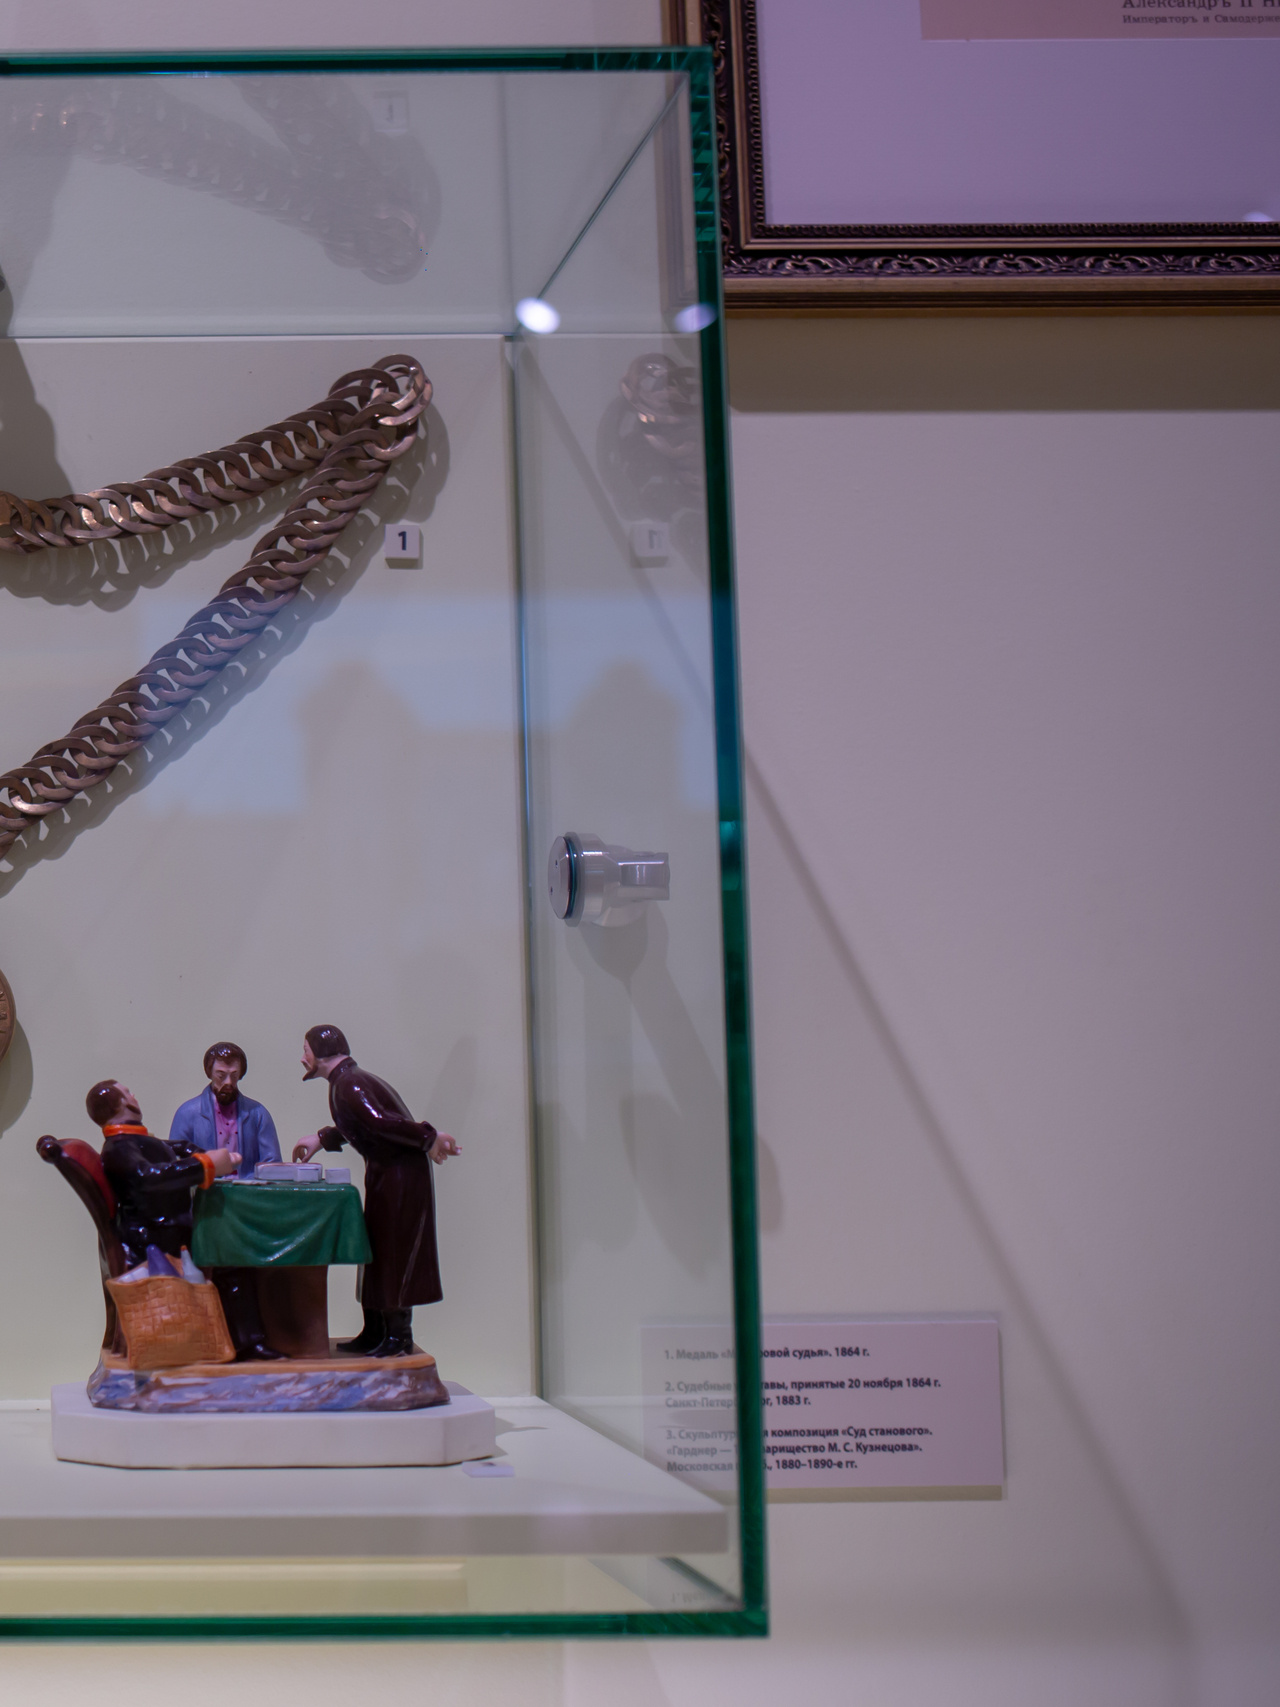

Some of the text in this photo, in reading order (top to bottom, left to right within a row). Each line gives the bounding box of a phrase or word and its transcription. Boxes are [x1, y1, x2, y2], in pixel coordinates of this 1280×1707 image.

[397, 530, 407, 551] 1
[676, 1349, 719, 1361] Медаль
[792, 1348, 832, 1361] судья».
[834, 1346, 860, 1358] 1864
[862, 1348, 870, 1357] г.
[665, 1376, 942, 1394] 2. Судебные принятые 20 ноября 1864 г.
[775, 1395, 811, 1406] 1883 г.
[771, 1428, 839, 1440] композиция
[842, 1425, 866, 1439] «Суд
[869, 1427, 932, 1437] станового».
[828, 1442, 840, 1453] М.
[843, 1442, 853, 1453] С.
[856, 1441, 922, 1455] Кузнецова».
[667, 1461, 733, 1473] Московская
[845, 1460, 858, 1469] гг.
